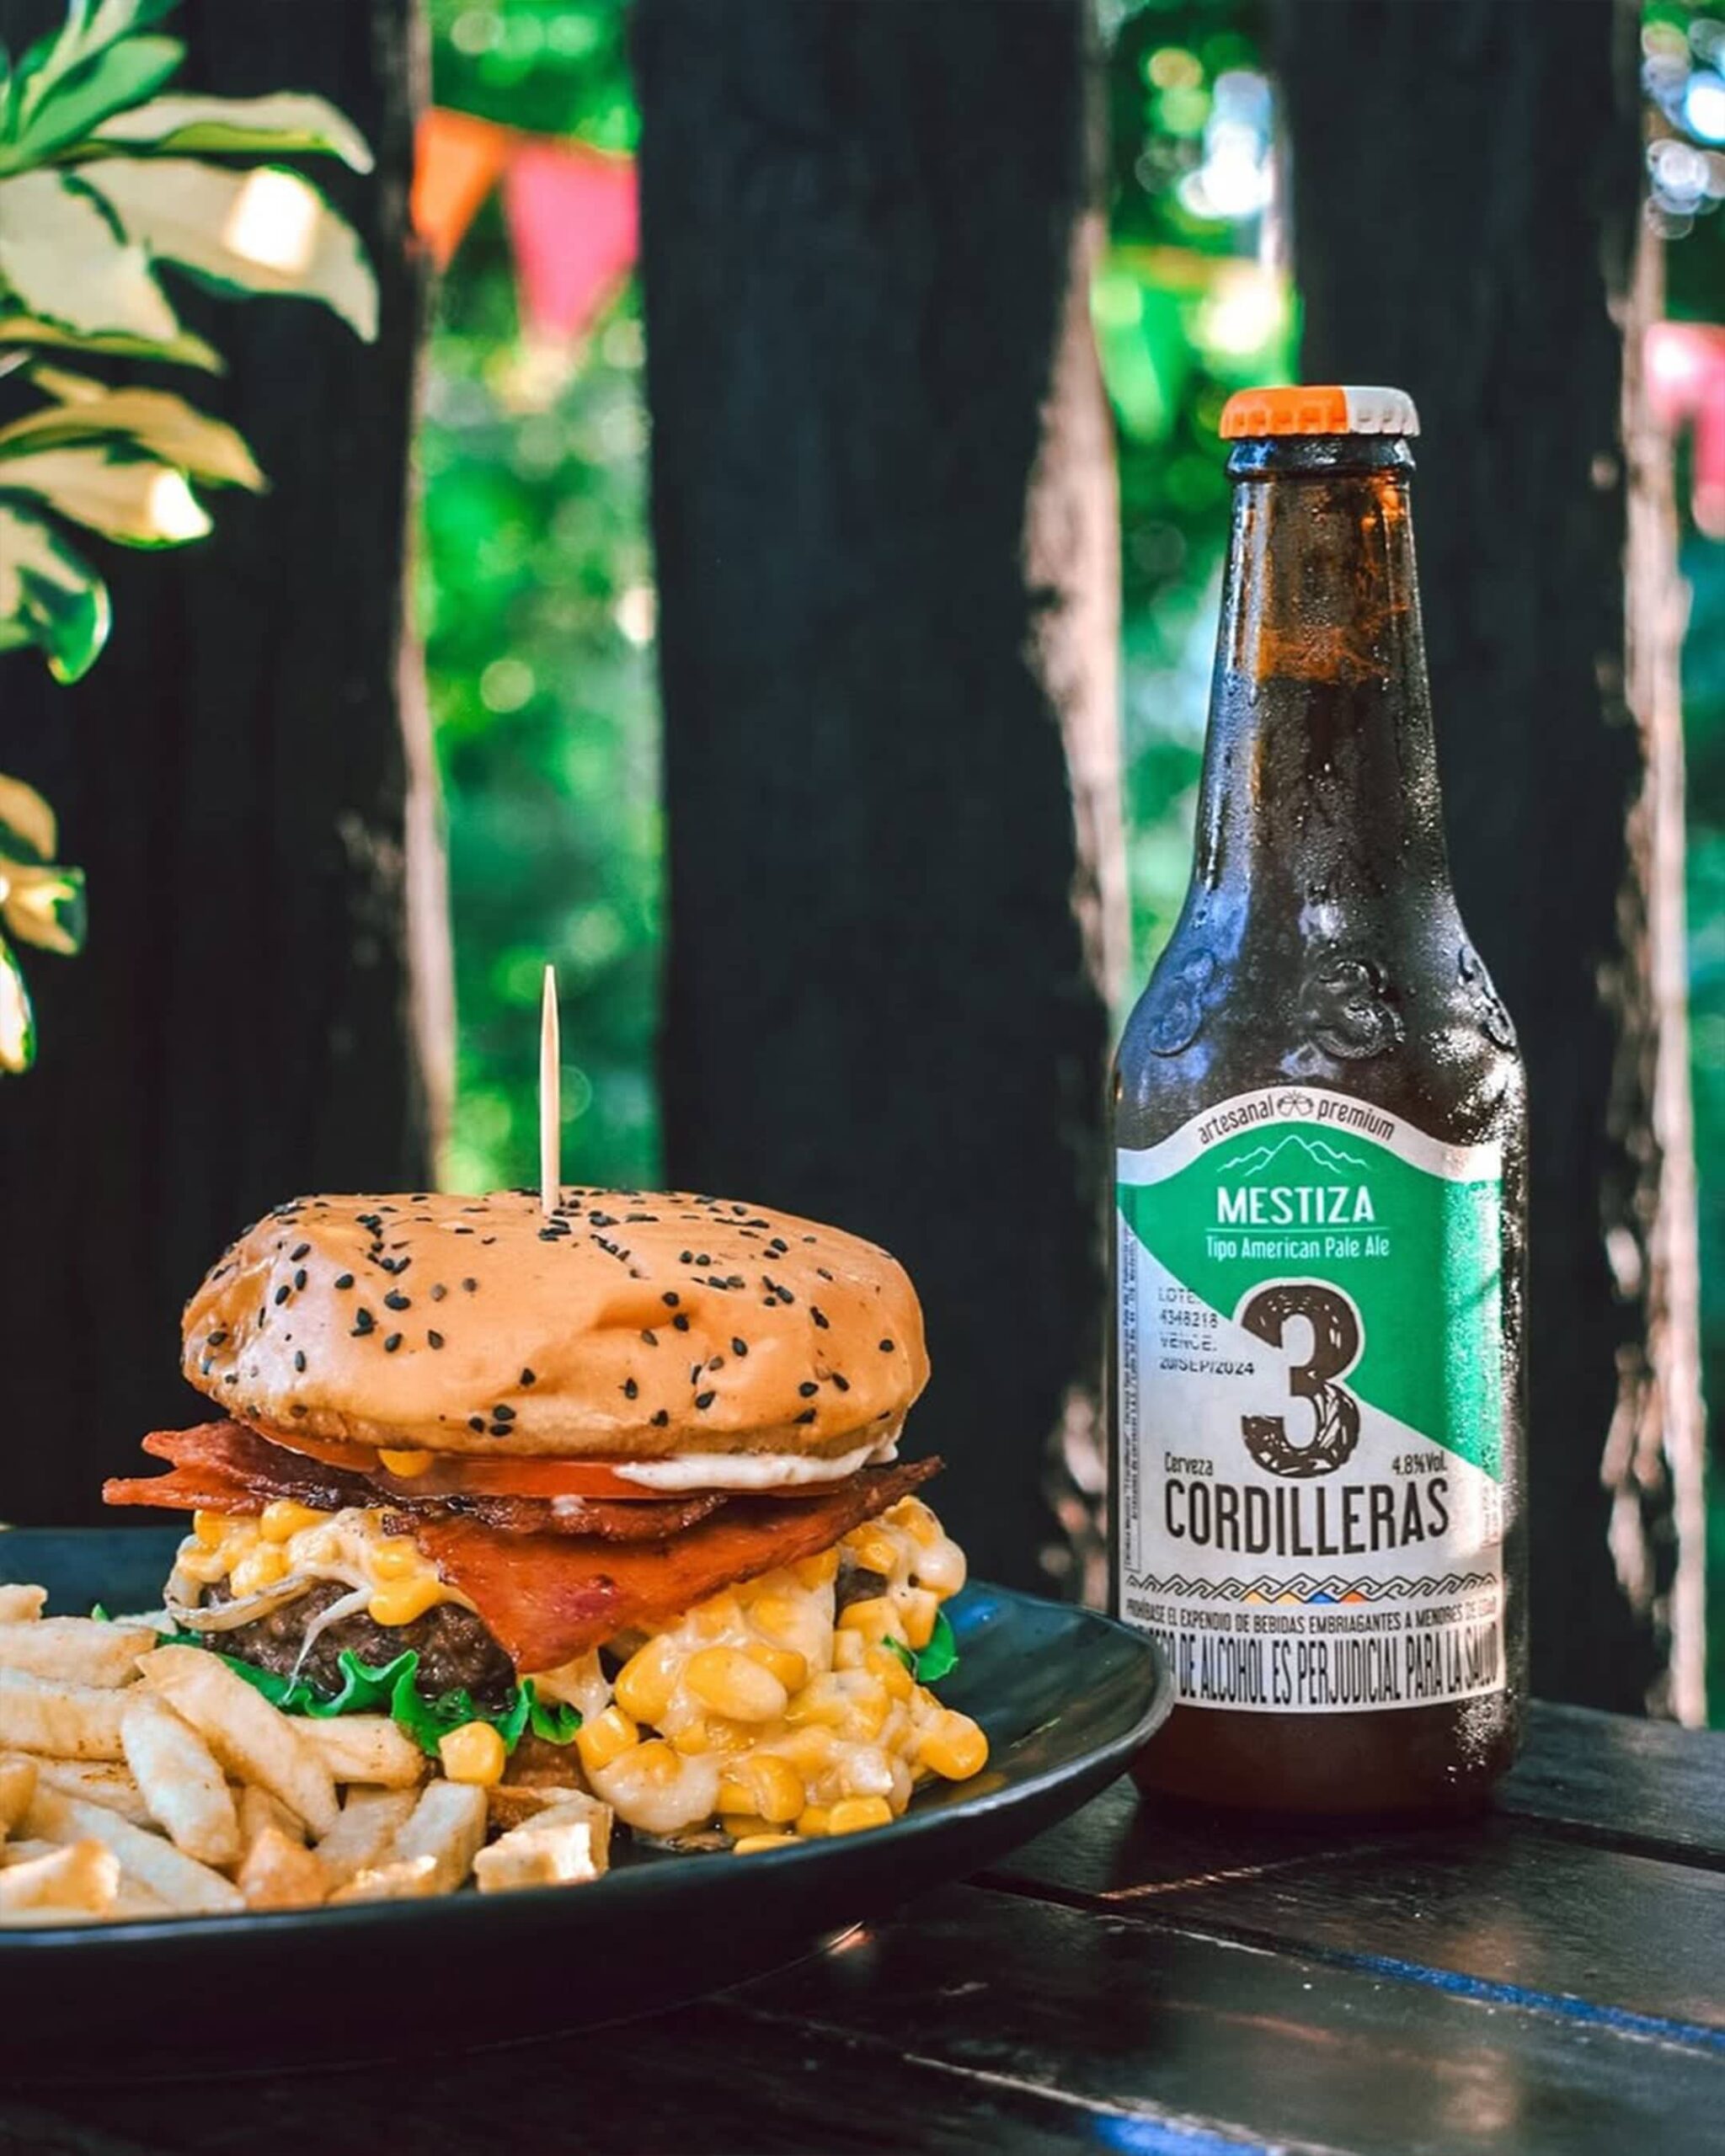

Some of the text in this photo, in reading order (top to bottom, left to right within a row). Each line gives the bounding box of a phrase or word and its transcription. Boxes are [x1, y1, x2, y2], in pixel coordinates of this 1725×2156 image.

[1199, 1096, 1395, 1145] artesanal premium
[1217, 1186, 1375, 1225] MESTIZA
[1206, 1235, 1390, 1262] Tipo American Pale Ale
[1241, 1283, 1361, 1479] 3
[1164, 1451, 1213, 1476] Cerveza
[1165, 1478, 1449, 1556] CORDILLERAS
[1167, 1607, 1178, 1626] EL
[1181, 1609, 1231, 1632] EXPENDIO
[1235, 1612, 1250, 1633] DE
[1253, 1614, 1305, 1635] BEBIDAS
[1309, 1612, 1401, 1636] EMBRIAGANTES
[1404, 1610, 1413, 1630] A
[1416, 1604, 1462, 1628] MENORES
[1180, 1634, 1196, 1699] DE
[1200, 1636, 1267, 1705] ALCOHOL
[1273, 1640, 1292, 1705] ES
[1297, 1636, 1401, 1705] PERJUDICIAL
[1406, 1630, 1443, 1700] PARA
[1446, 1628, 1462, 1693] LA
